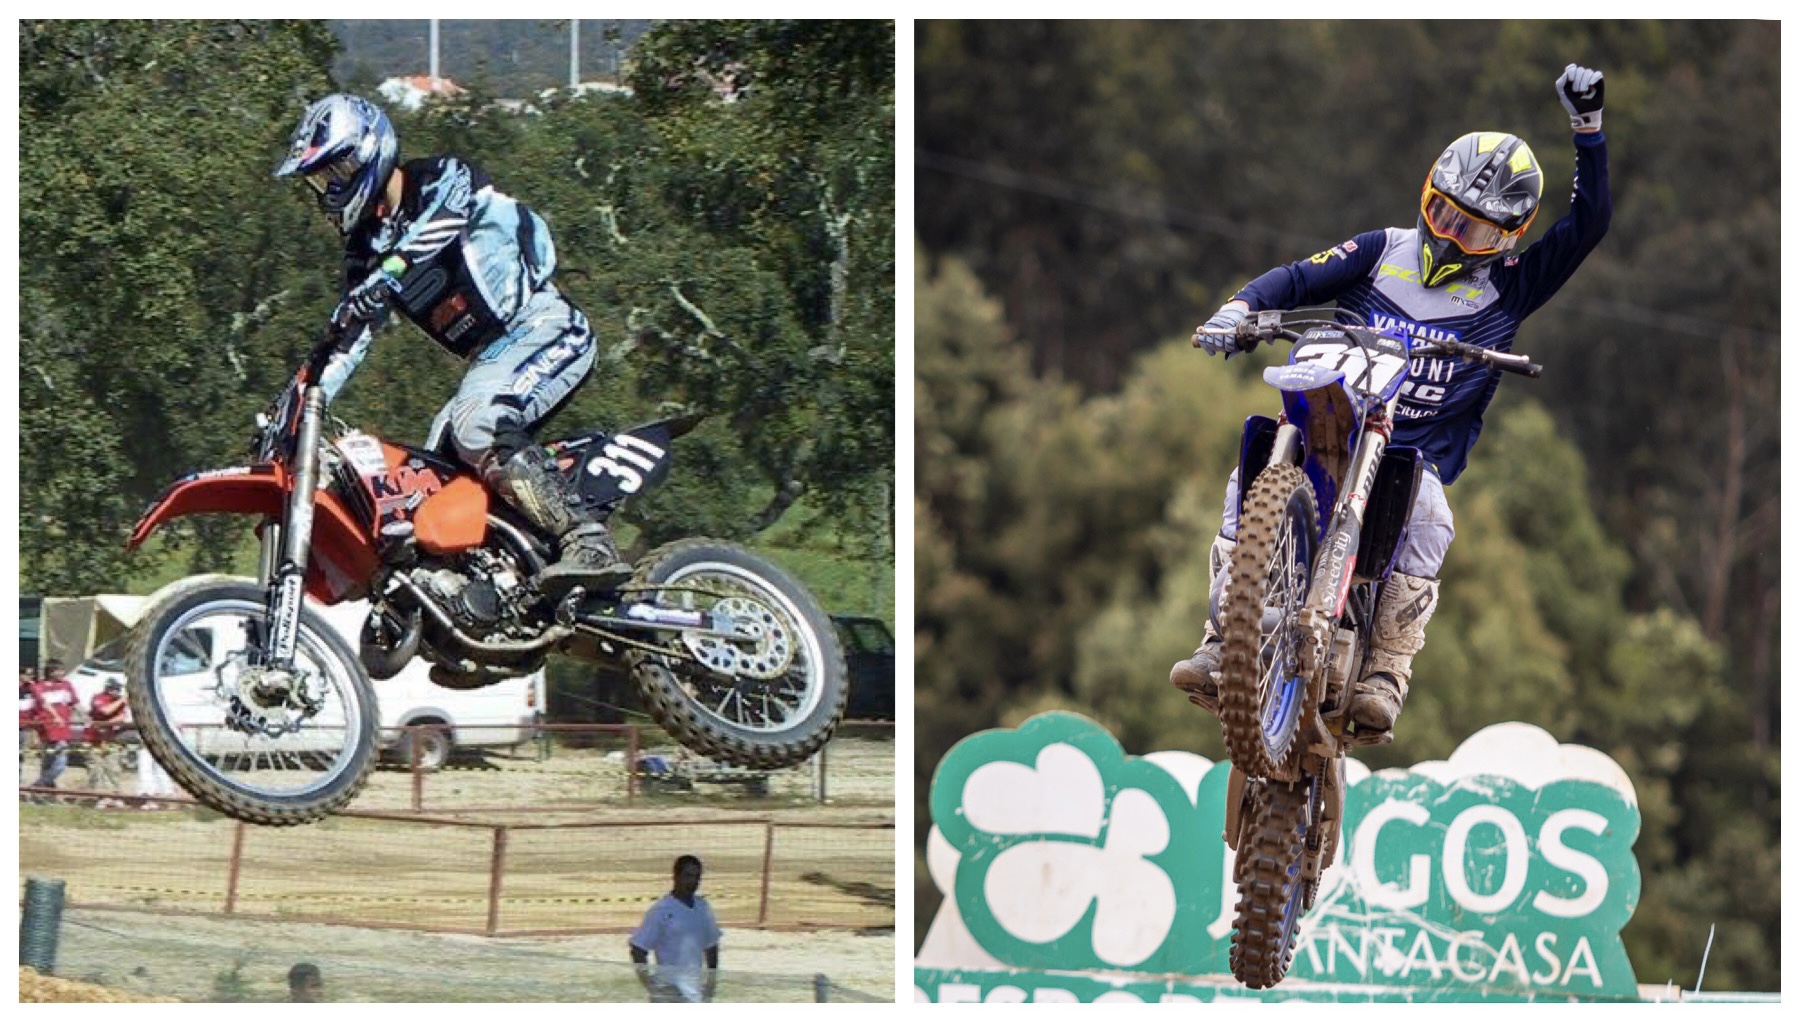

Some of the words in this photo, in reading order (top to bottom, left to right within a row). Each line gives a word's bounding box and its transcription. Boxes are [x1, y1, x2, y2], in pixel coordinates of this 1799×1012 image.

[1294, 343, 1407, 394] 311
[587, 434, 666, 493] 311
[1207, 798, 1610, 939] JGOS
[1299, 923, 1604, 988] ANTACASA
